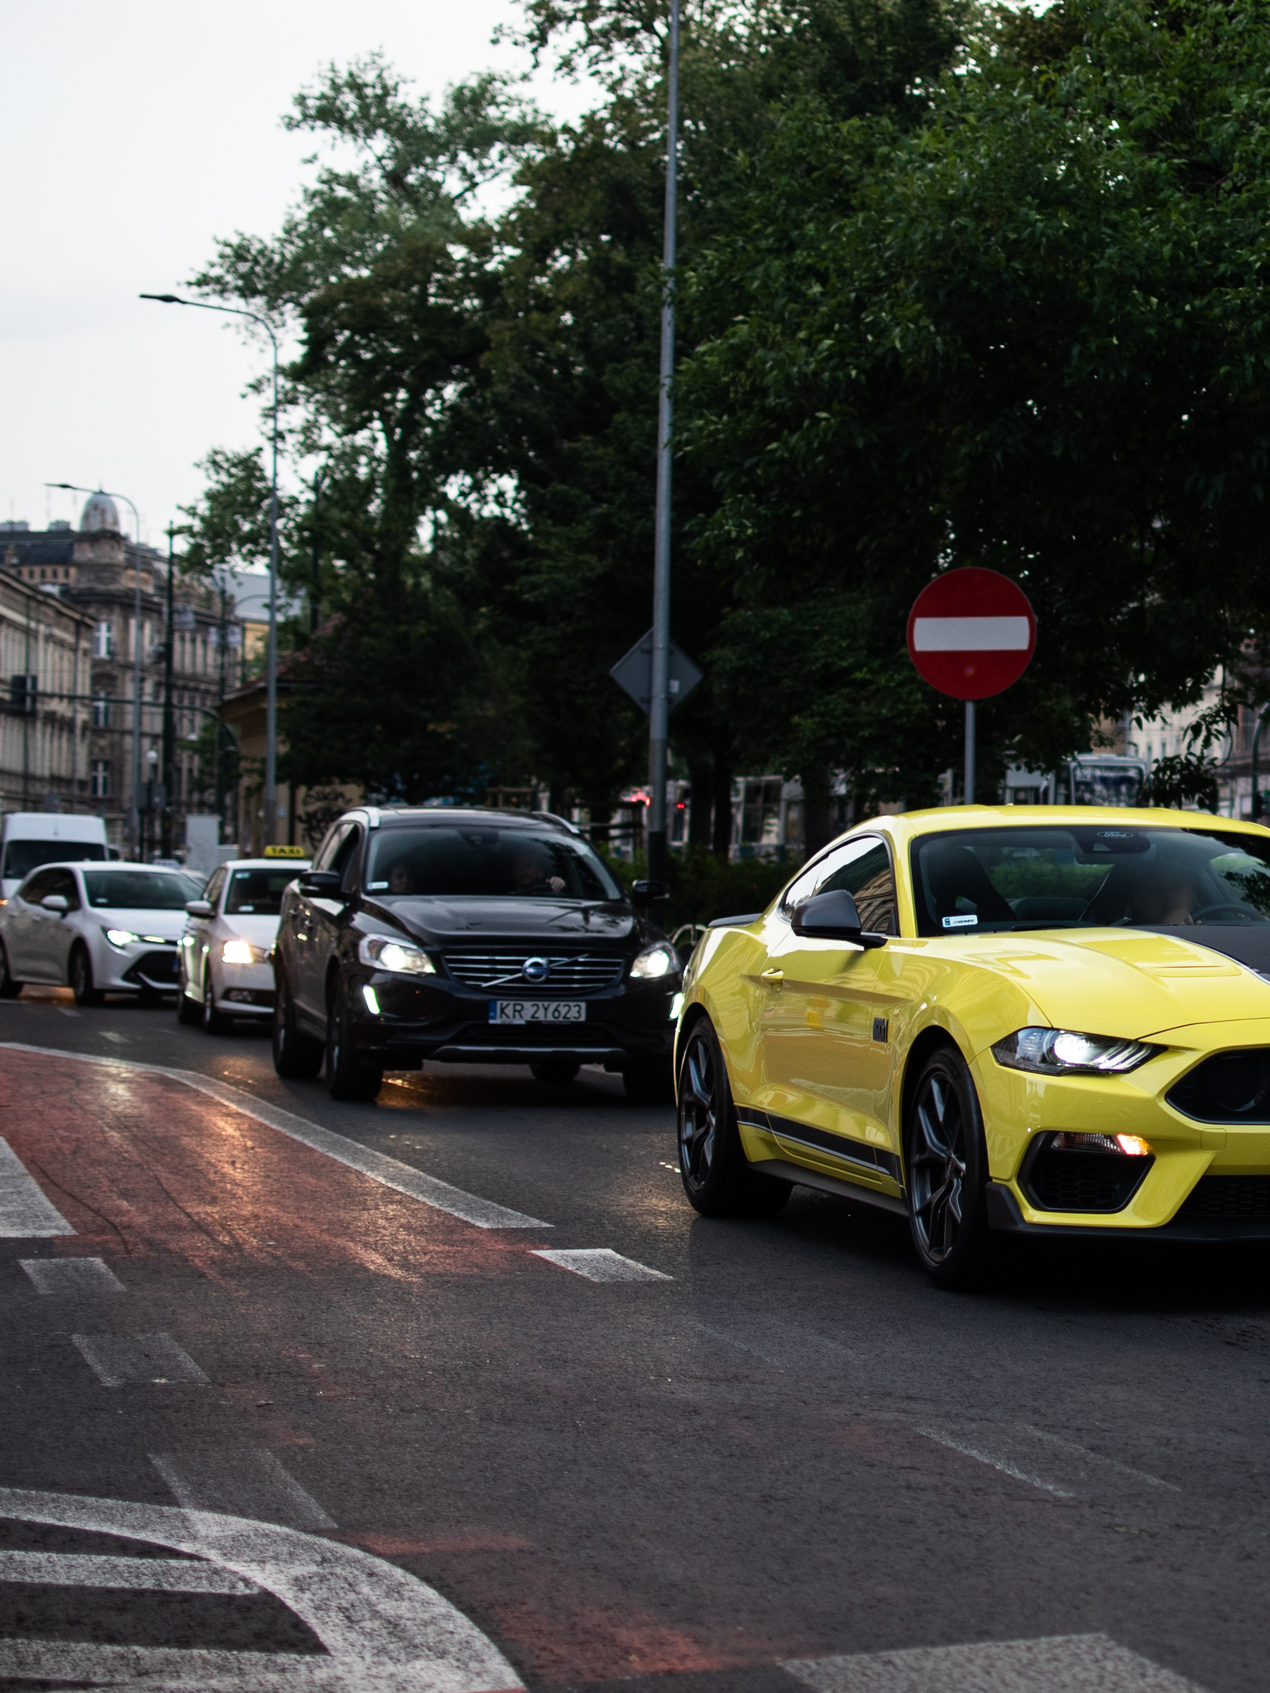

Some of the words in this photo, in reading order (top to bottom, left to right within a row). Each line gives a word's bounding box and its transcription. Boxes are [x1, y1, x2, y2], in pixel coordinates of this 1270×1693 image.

[271, 847, 300, 855] TAXI
[500, 1003, 525, 1019] KR
[530, 1003, 582, 1020] 2Y623
